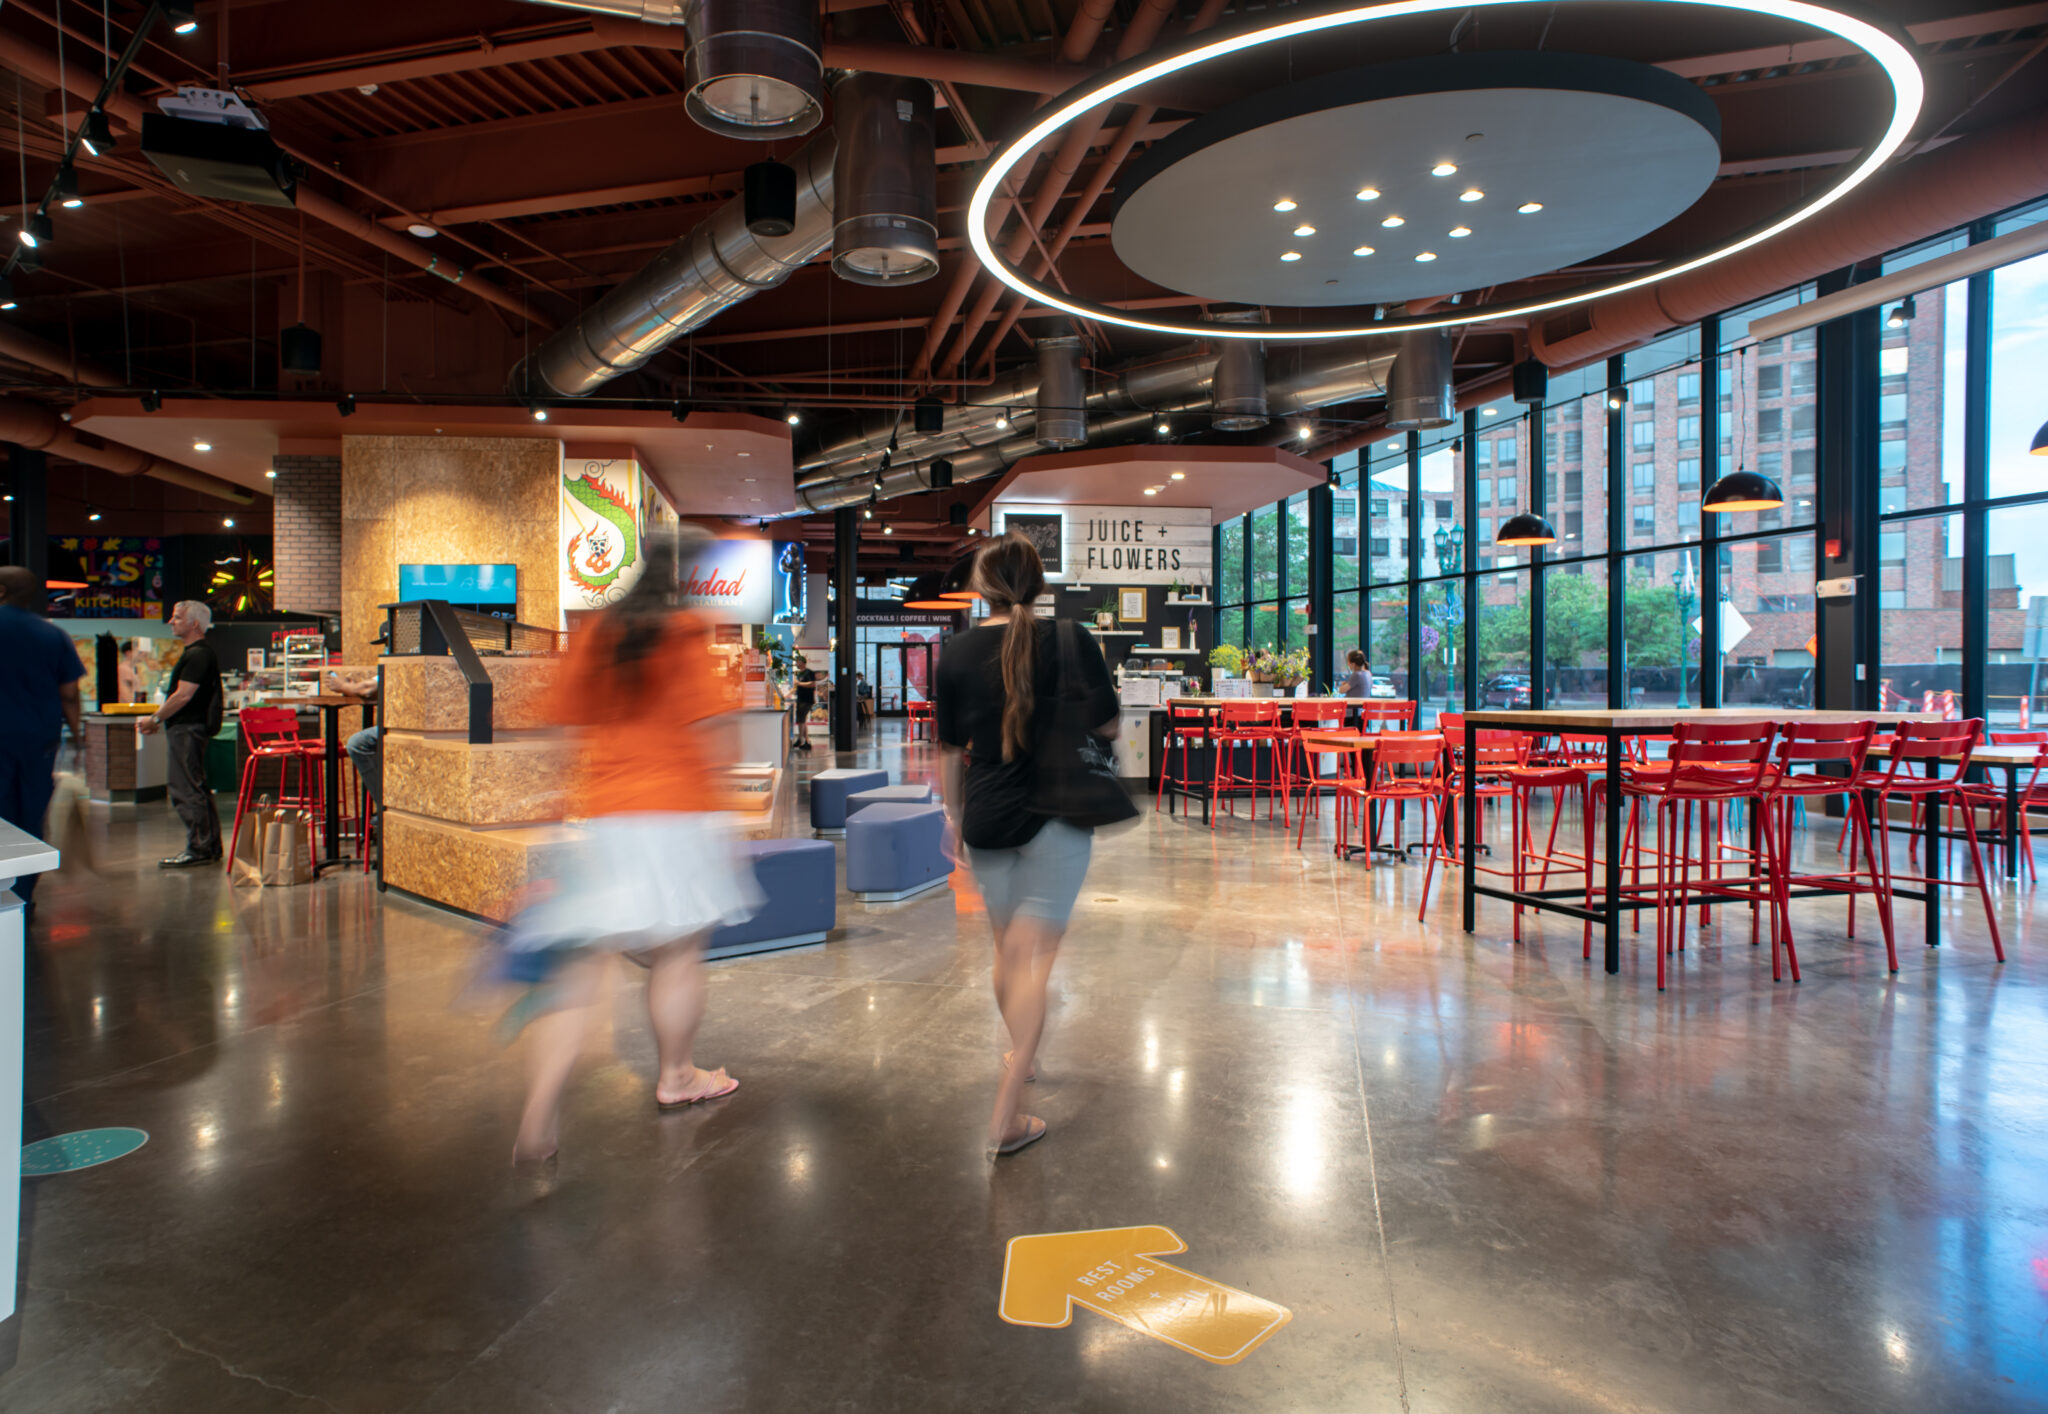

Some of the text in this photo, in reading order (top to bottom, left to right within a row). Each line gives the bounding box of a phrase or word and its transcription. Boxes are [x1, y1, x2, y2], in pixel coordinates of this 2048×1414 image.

[1087, 519, 1167, 542] JUICE +
[1088, 547, 1181, 570] FLOWERS
[680, 565, 746, 596] hdad
[75, 597, 141, 608] KITCHEN
[1077, 1260, 1122, 1287] REST
[1095, 1266, 1155, 1302] ROOMS
